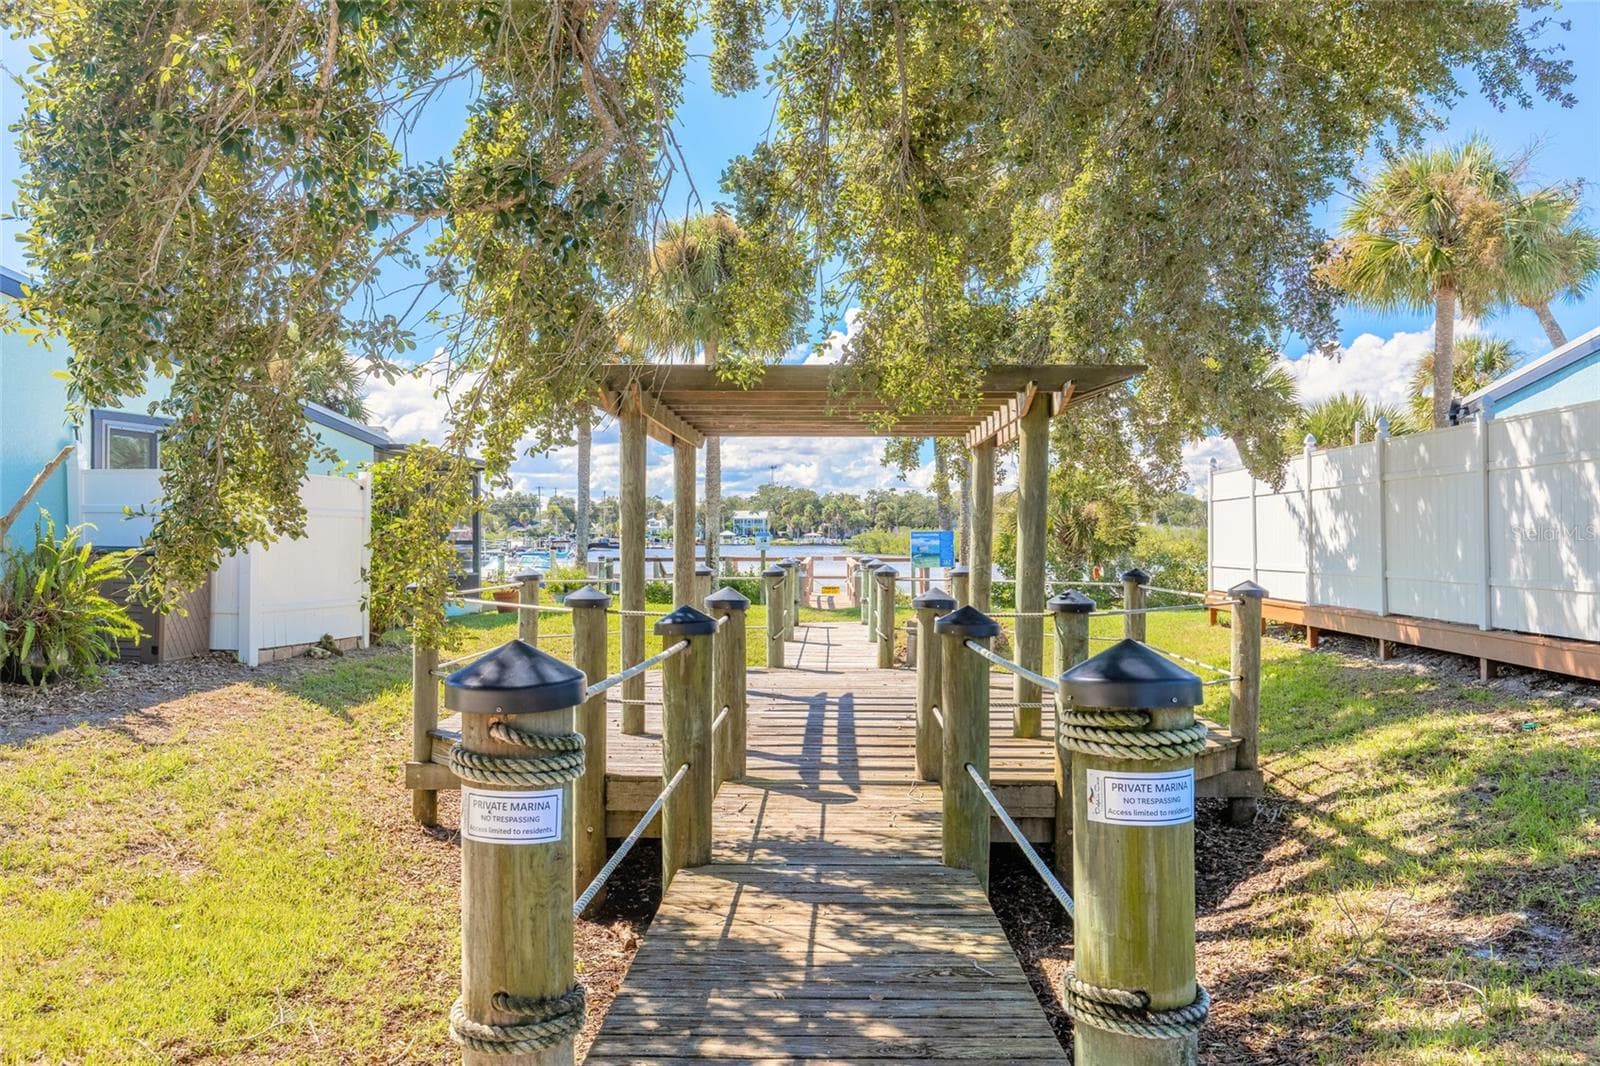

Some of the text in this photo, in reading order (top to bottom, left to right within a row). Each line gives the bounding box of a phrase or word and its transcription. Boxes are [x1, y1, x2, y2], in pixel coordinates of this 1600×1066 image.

[1111, 781, 1188, 793] PRIVATE MARINA
[473, 799, 551, 811] PRIVATE MARINA
[1123, 796, 1182, 805] NO TRESPASSING
[1108, 808, 1132, 816] Access
[1134, 808, 1159, 817] limited
[1160, 809, 1167, 817] to
[481, 814, 540, 823] NO TRESPASSING
[469, 824, 488, 833] Access
[488, 826, 512, 835] limited
